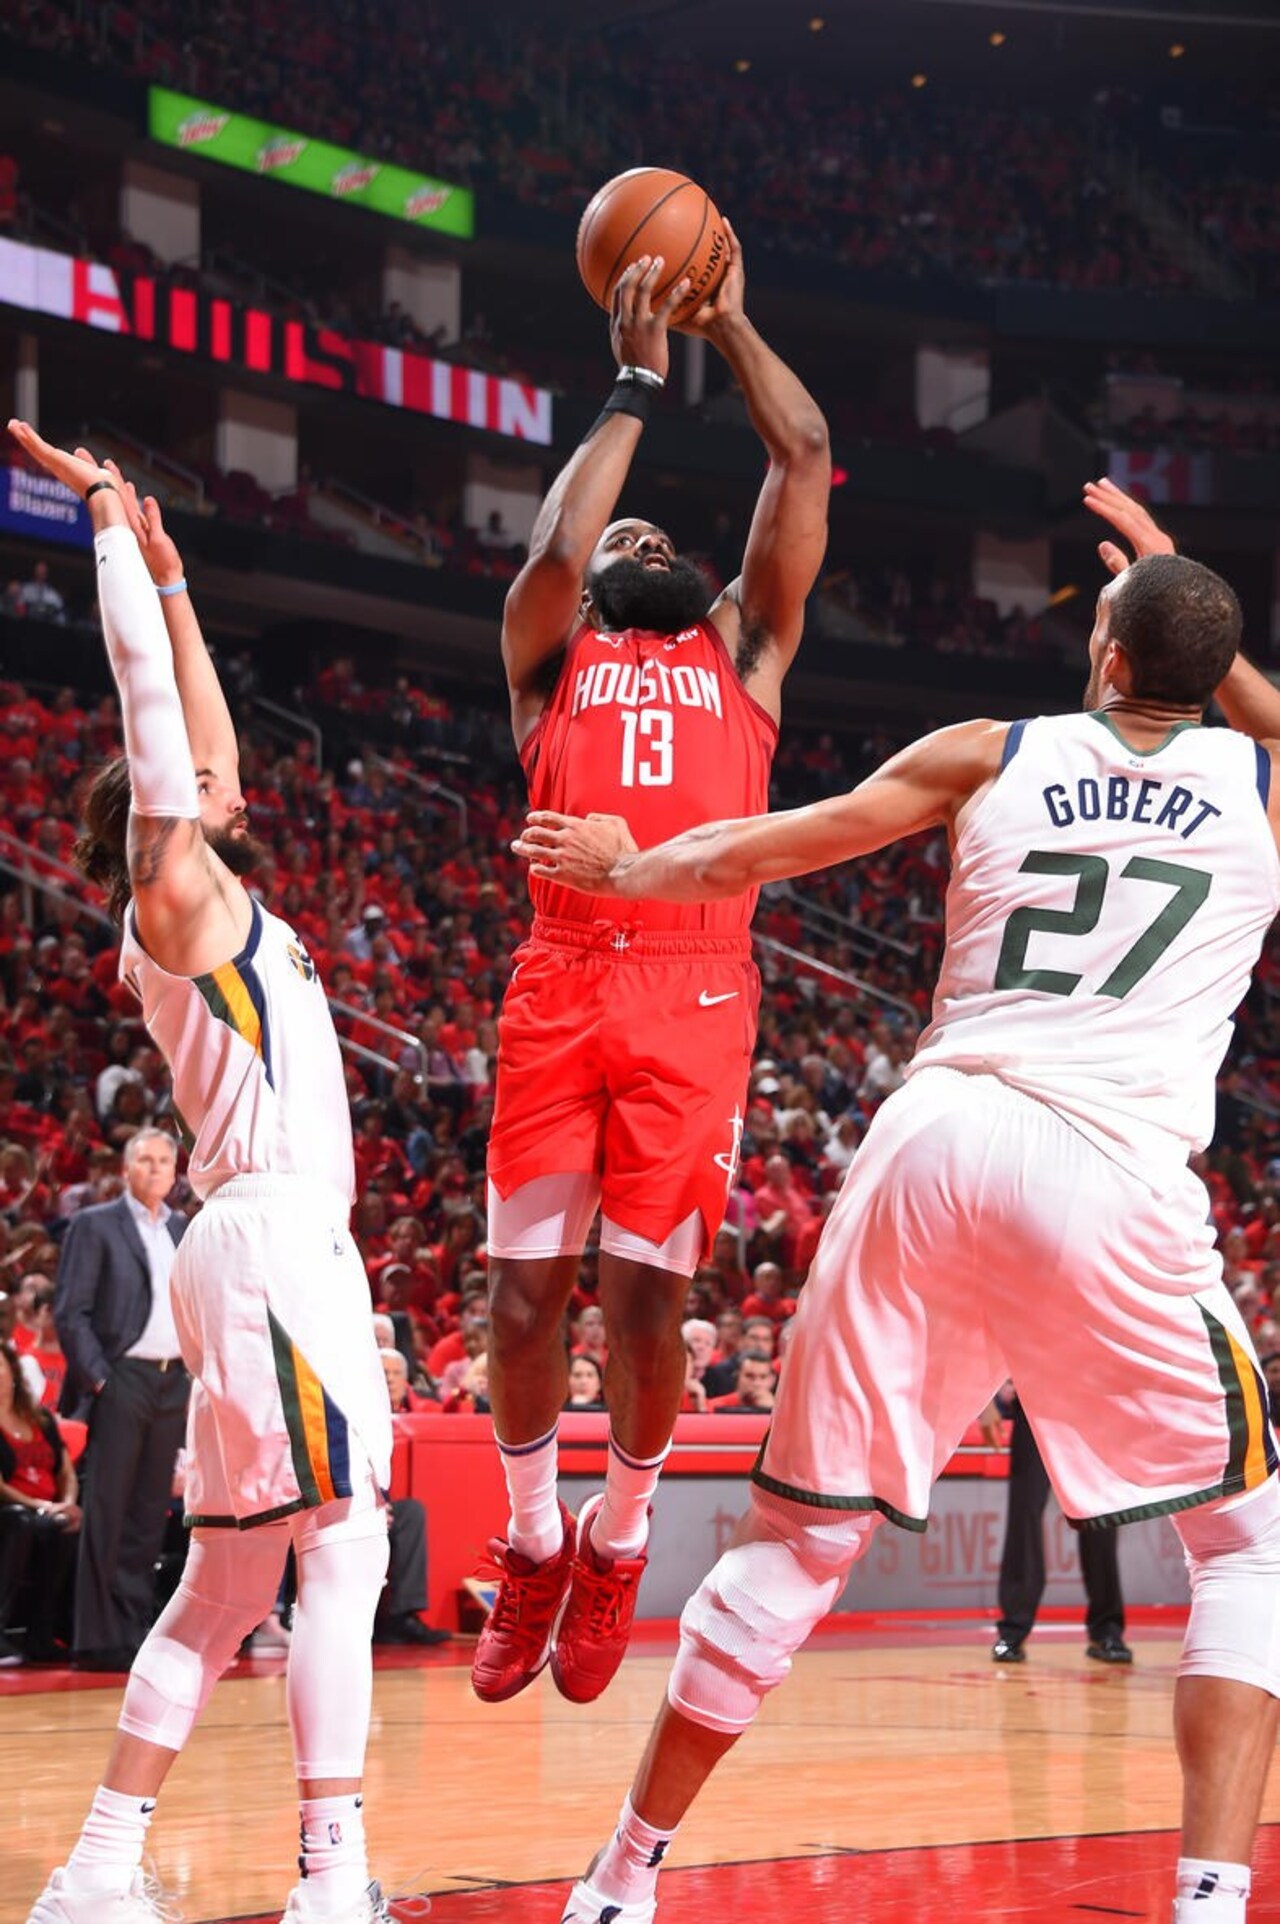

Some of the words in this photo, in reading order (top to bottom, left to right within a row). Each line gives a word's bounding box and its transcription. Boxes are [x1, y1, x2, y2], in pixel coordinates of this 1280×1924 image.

[674, 231, 725, 312] ALDING
[9, 490, 78, 524] Blazers
[571, 657, 723, 720] HOUSTON
[620, 708, 674, 788] 13
[1042, 775, 1222, 840] GOBERT
[993, 850, 1213, 1000] 27
[919, 1510, 1002, 1575] GIVE
